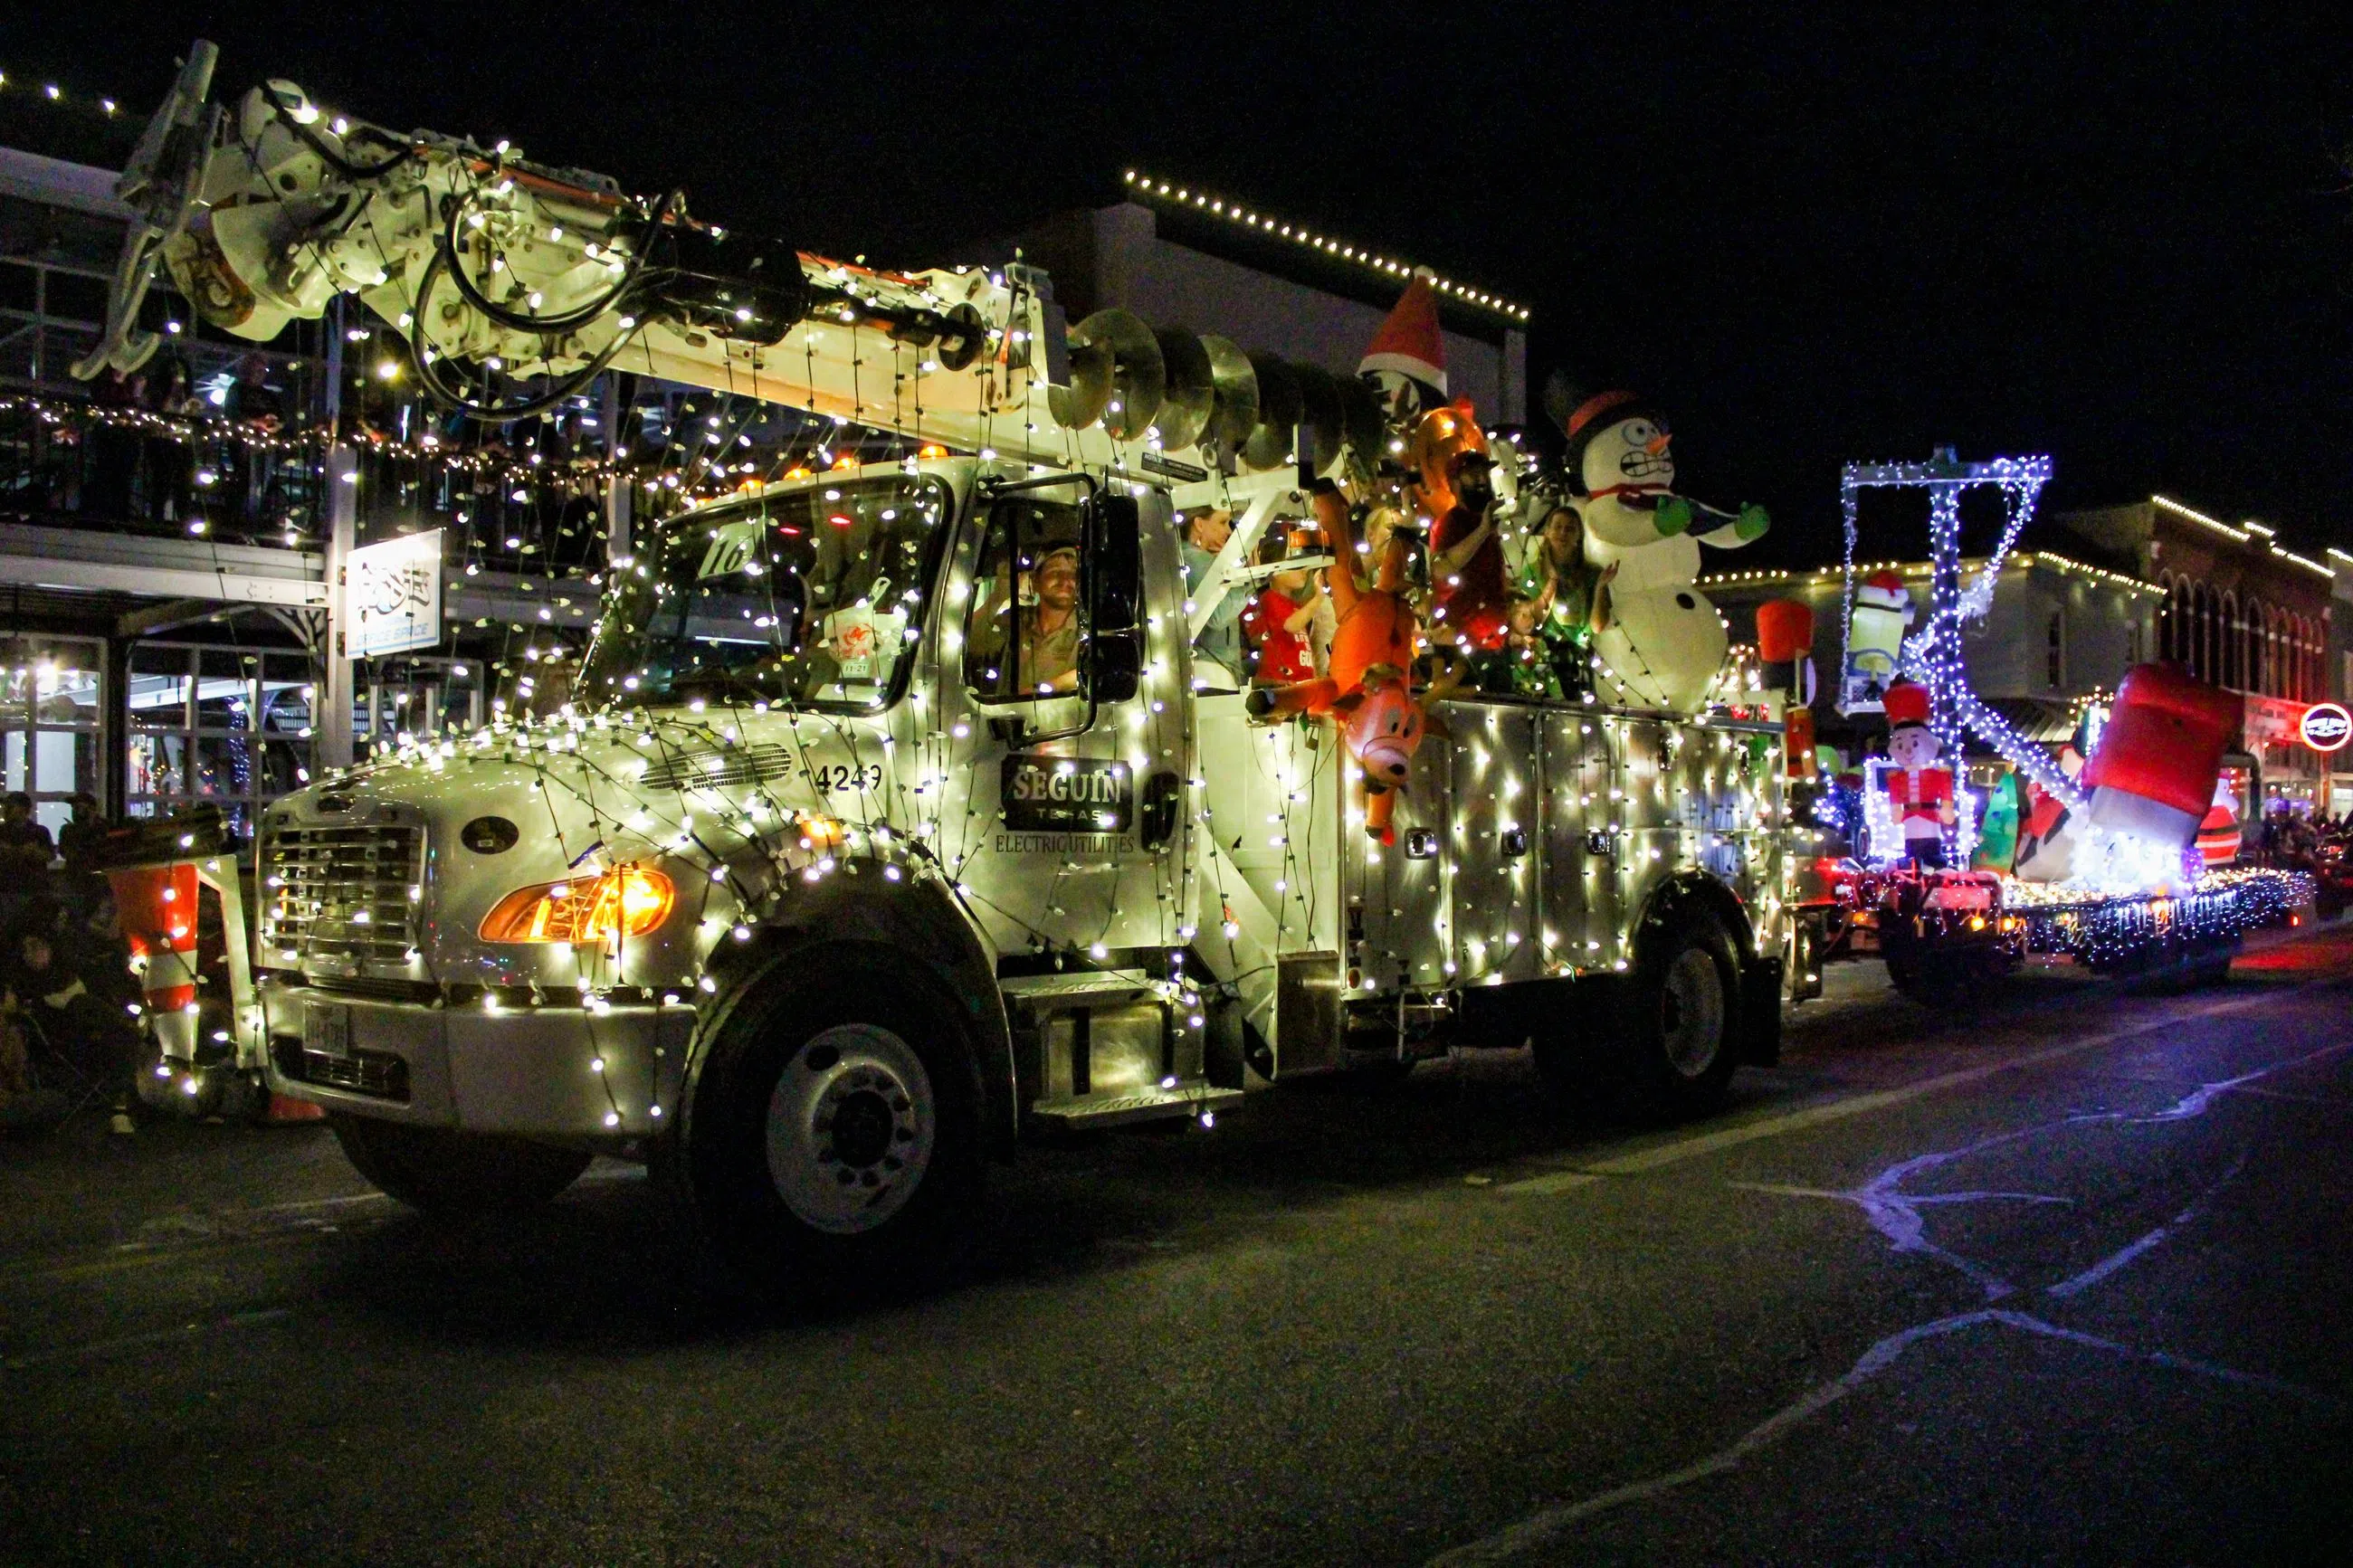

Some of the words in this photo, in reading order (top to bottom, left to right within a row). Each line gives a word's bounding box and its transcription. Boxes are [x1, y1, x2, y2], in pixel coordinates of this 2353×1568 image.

[1013, 769, 1122, 803] SEGUIN
[1035, 808, 1103, 822] TEAS
[996, 834, 1066, 853] ELECTRIC
